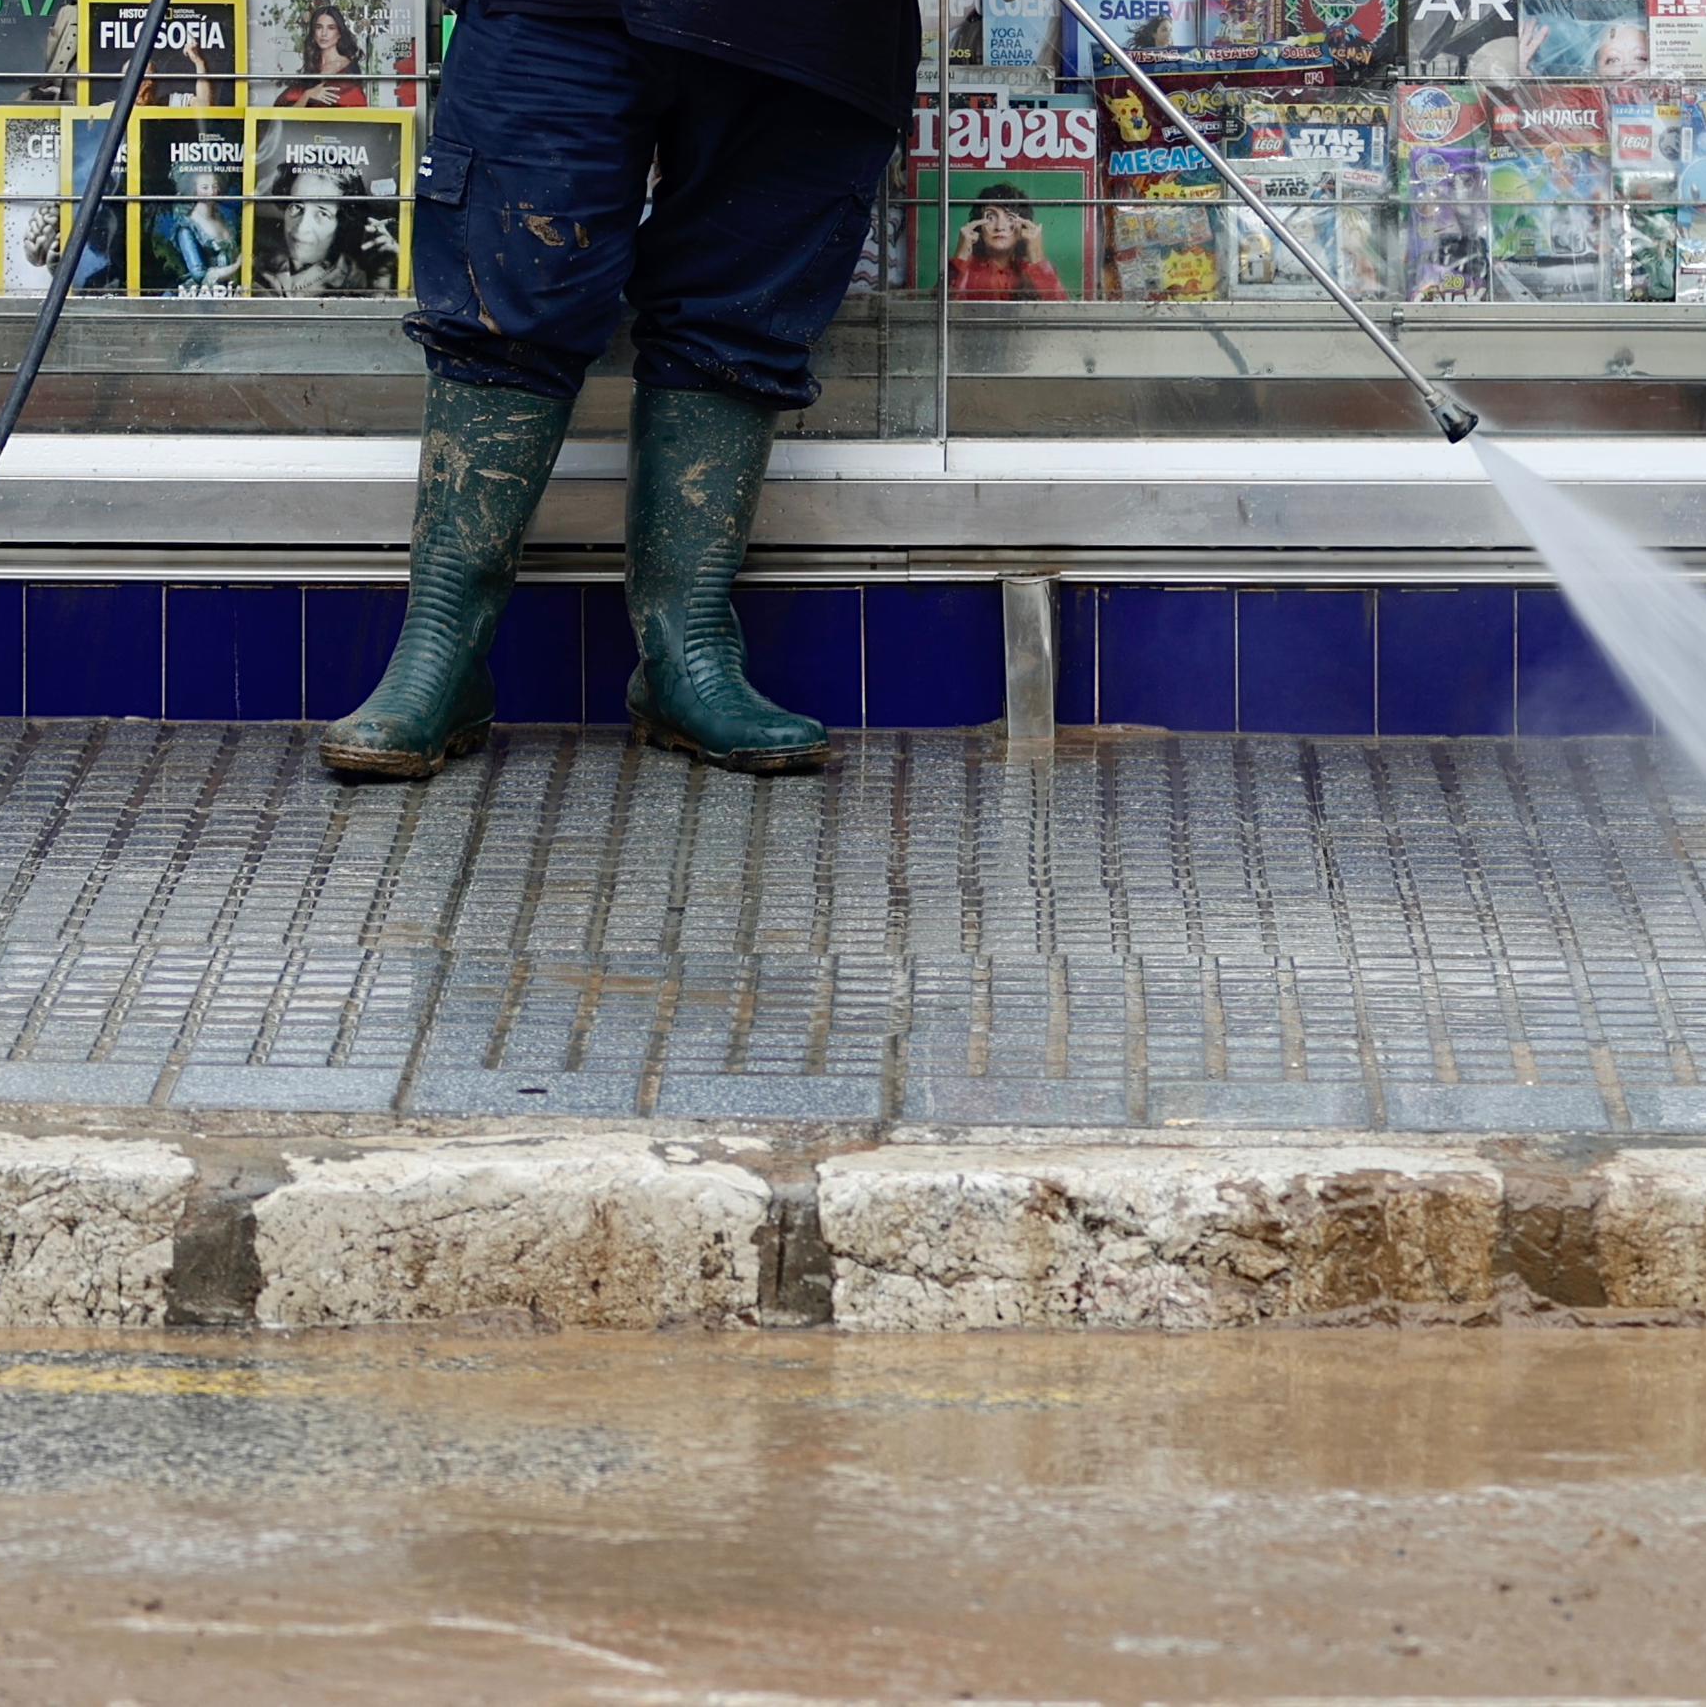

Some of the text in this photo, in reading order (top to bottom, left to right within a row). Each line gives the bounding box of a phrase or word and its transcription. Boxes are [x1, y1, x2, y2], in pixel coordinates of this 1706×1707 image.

[1099, 0, 1172, 20] SABER
[100, 16, 225, 49] FILOSOFÍA
[990, 28, 1024, 39] YOGA
[990, 39, 1022, 50] PARA
[990, 50, 1033, 60] GANAR
[1522, 110, 1599, 129] NINJAGO
[910, 94, 1097, 169] Tapas
[1291, 129, 1359, 145] STAR
[1254, 138, 1282, 151] LEGO
[1255, 140, 1282, 151] LEGO
[1622, 137, 1650, 147] LEGO
[285, 144, 370, 166] HISTORIA
[1292, 145, 1364, 162] WARS
[179, 165, 211, 173] GRANDES
[292, 167, 326, 175] GRANDES
